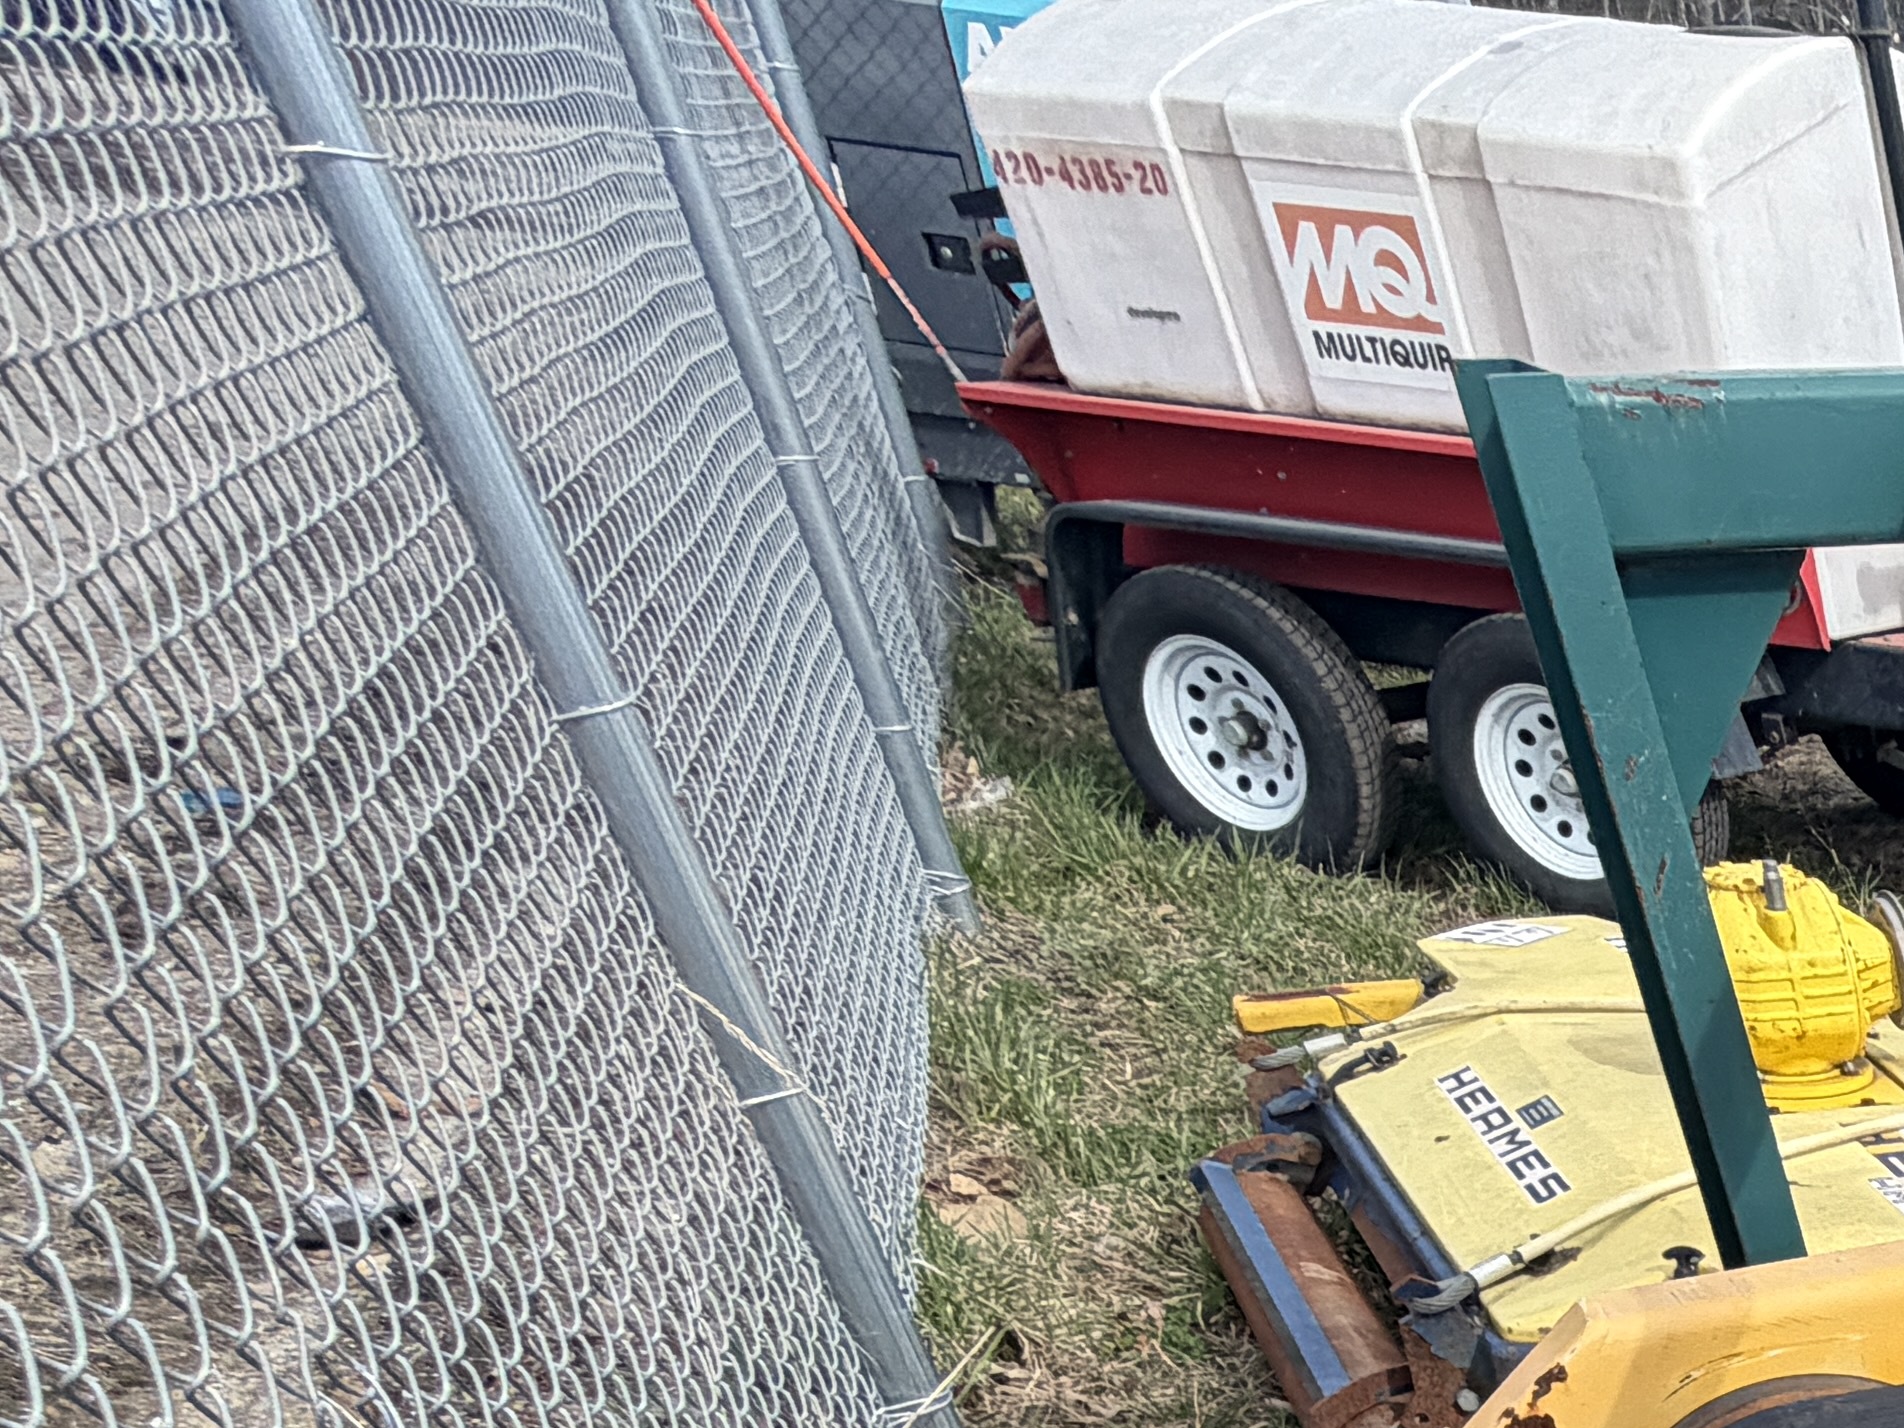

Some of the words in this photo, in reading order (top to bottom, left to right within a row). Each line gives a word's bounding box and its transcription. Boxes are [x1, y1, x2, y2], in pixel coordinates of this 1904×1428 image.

[992, 149, 1168, 196] 420-4385-20
[1286, 219, 1441, 323] MQ
[1437, 1065, 1572, 1204] HERMES
